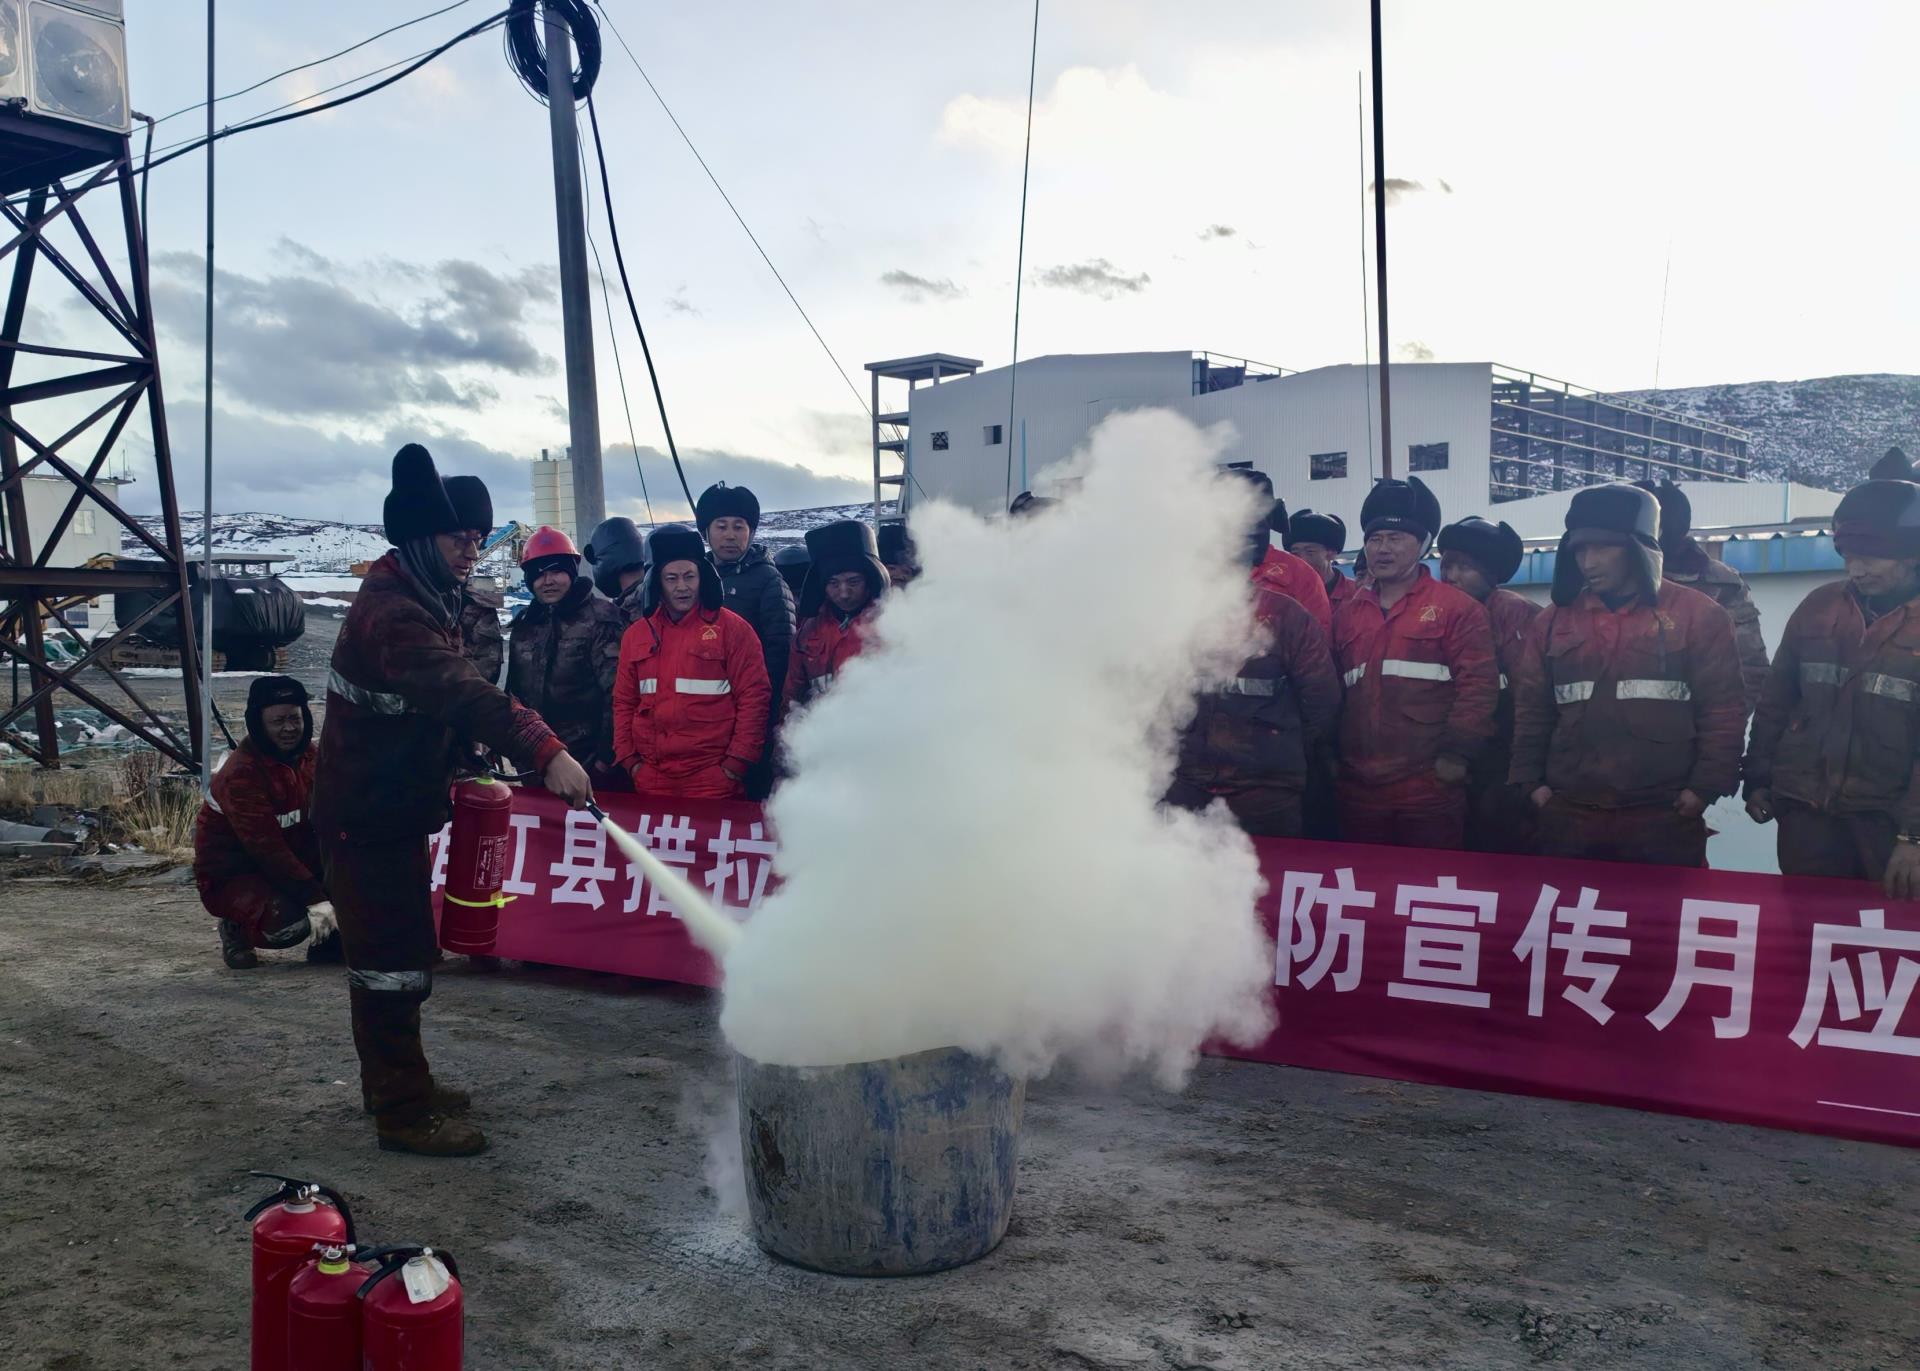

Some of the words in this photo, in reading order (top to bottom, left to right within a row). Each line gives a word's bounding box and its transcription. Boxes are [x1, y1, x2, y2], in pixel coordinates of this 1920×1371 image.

[1275, 867, 1920, 1057] 防宣传月应
